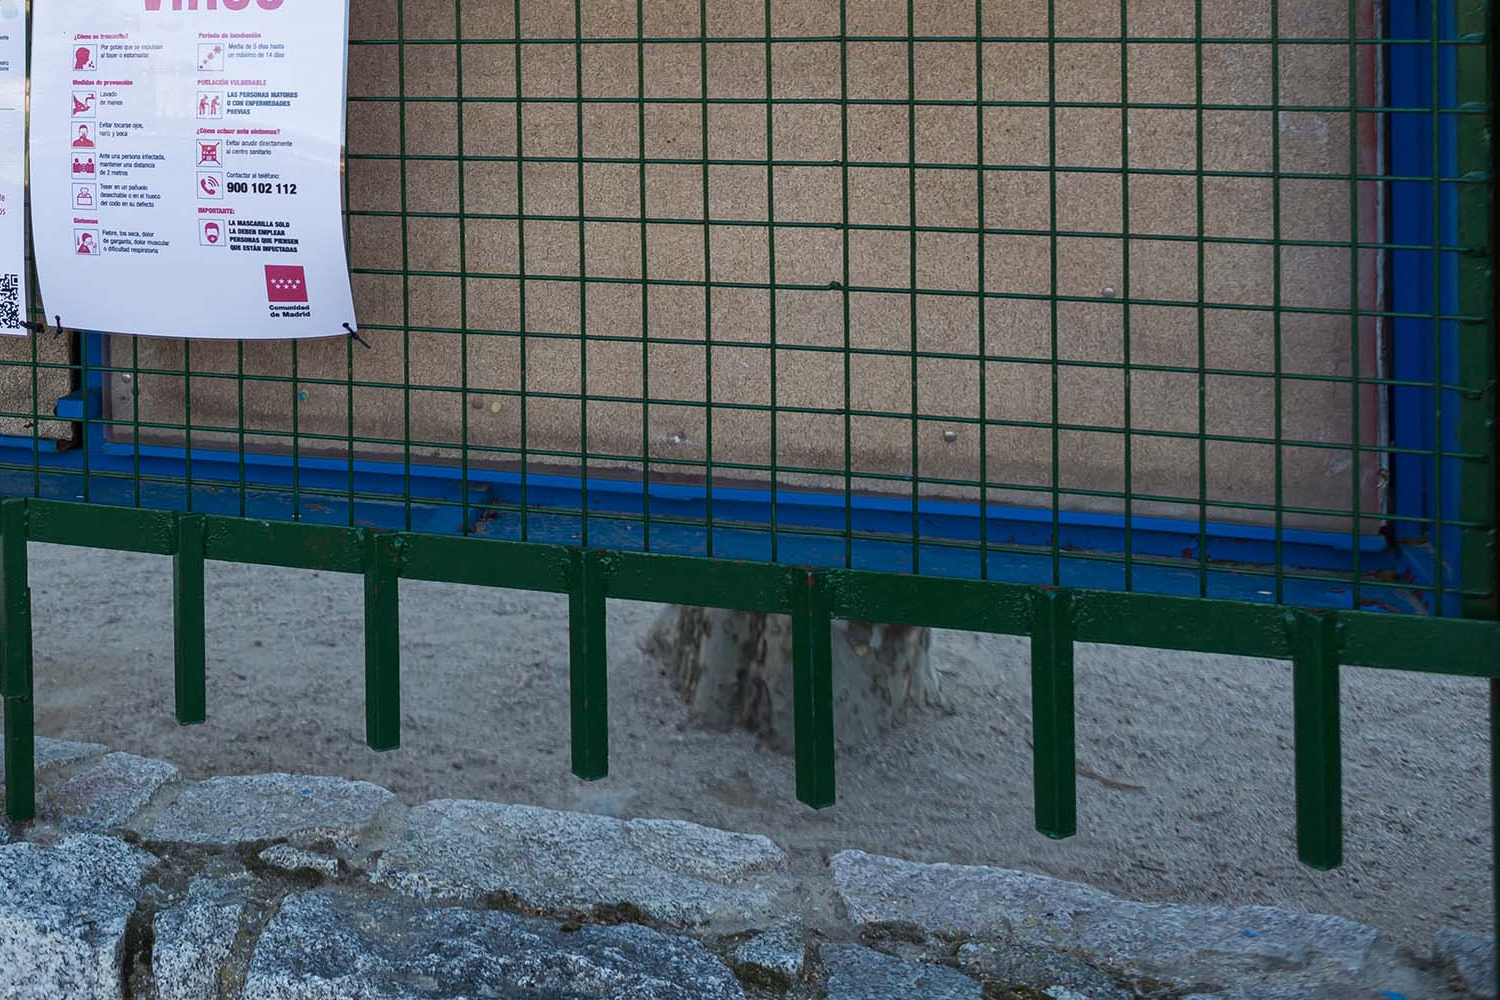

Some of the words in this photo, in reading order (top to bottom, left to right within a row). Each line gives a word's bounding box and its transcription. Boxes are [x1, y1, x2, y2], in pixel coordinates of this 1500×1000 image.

[128, 183, 148, 191] pañuelo
[226, 182, 248, 193] 900
[251, 182, 273, 194] 102
[276, 183, 297, 195] 112
[198, 207, 235, 215] IMPORTANTE:
[229, 236, 260, 244] PERSONAS
[261, 237, 273, 245] QUE
[242, 244, 261, 252] ESTÁN
[262, 245, 298, 253] INFECTADAS
